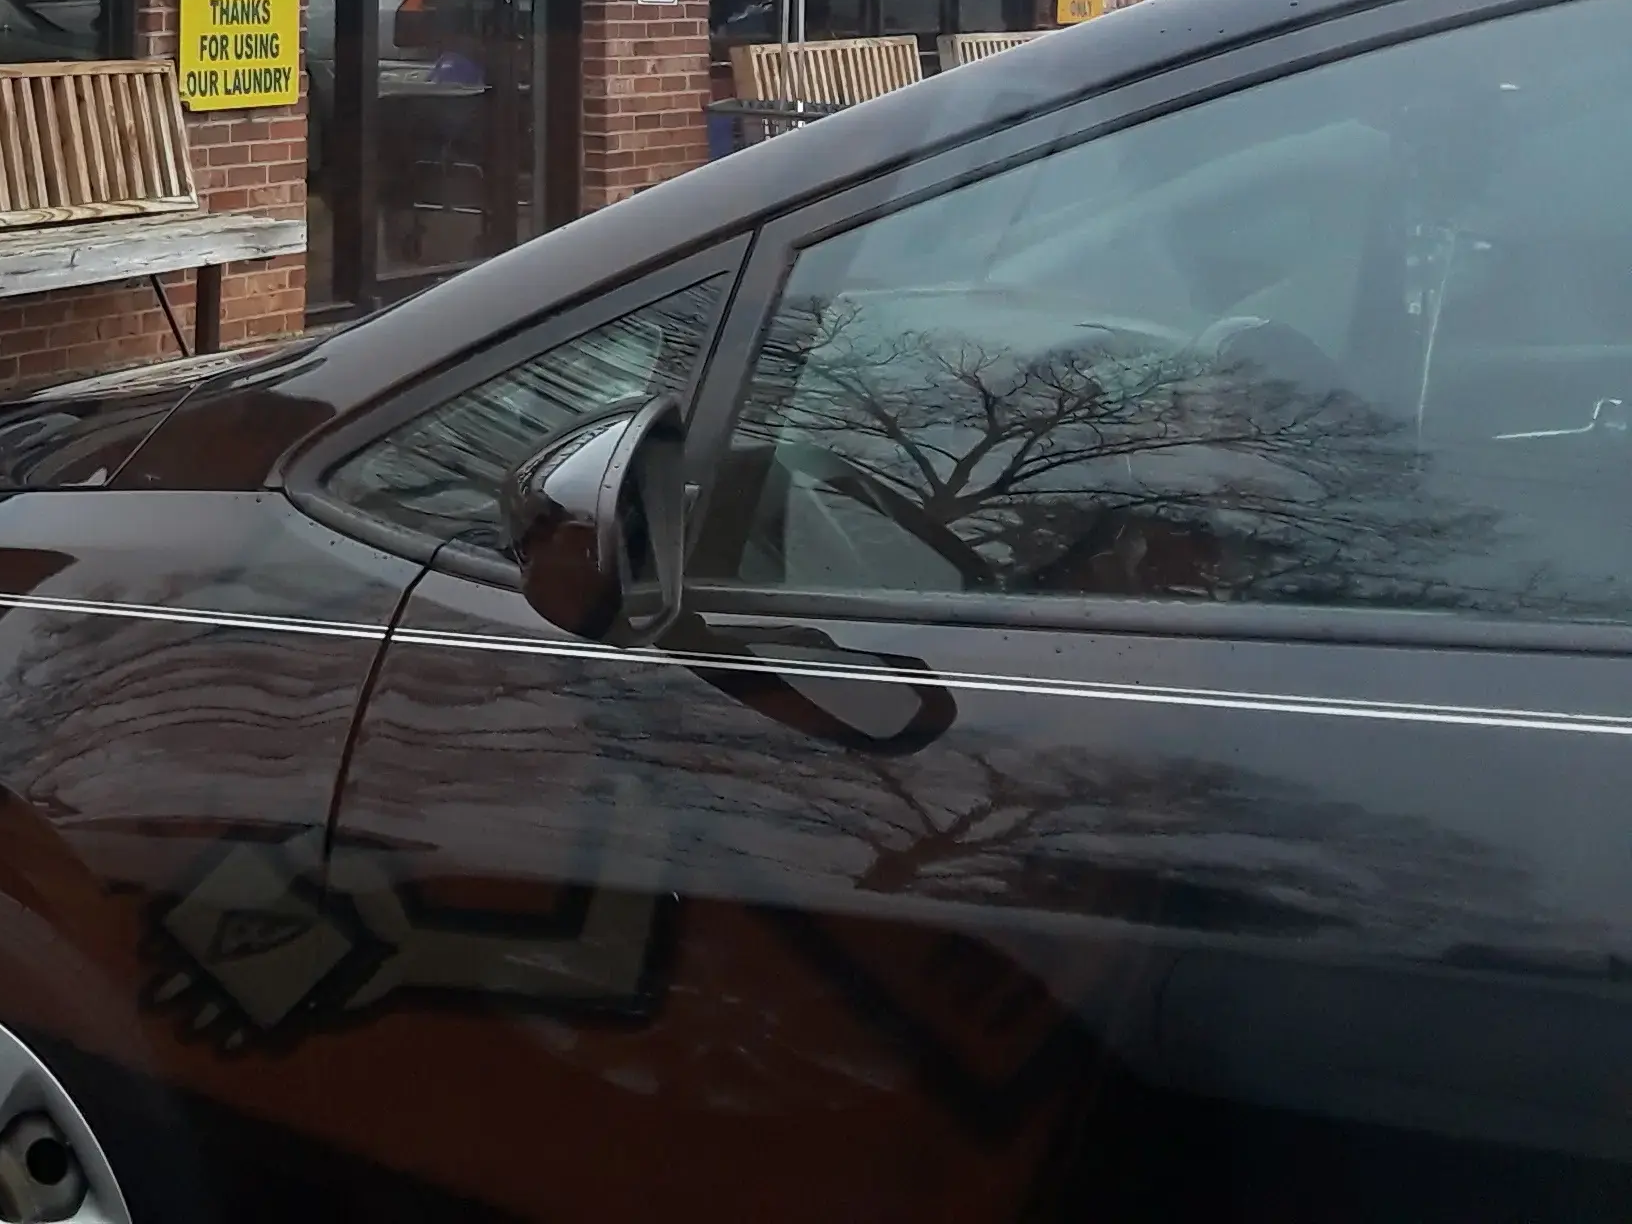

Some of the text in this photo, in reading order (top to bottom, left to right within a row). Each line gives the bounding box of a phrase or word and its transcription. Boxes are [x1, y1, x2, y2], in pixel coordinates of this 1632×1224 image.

[199, 32, 280, 62] FOR USING
[186, 66, 292, 98] OUR LAUNDRY
